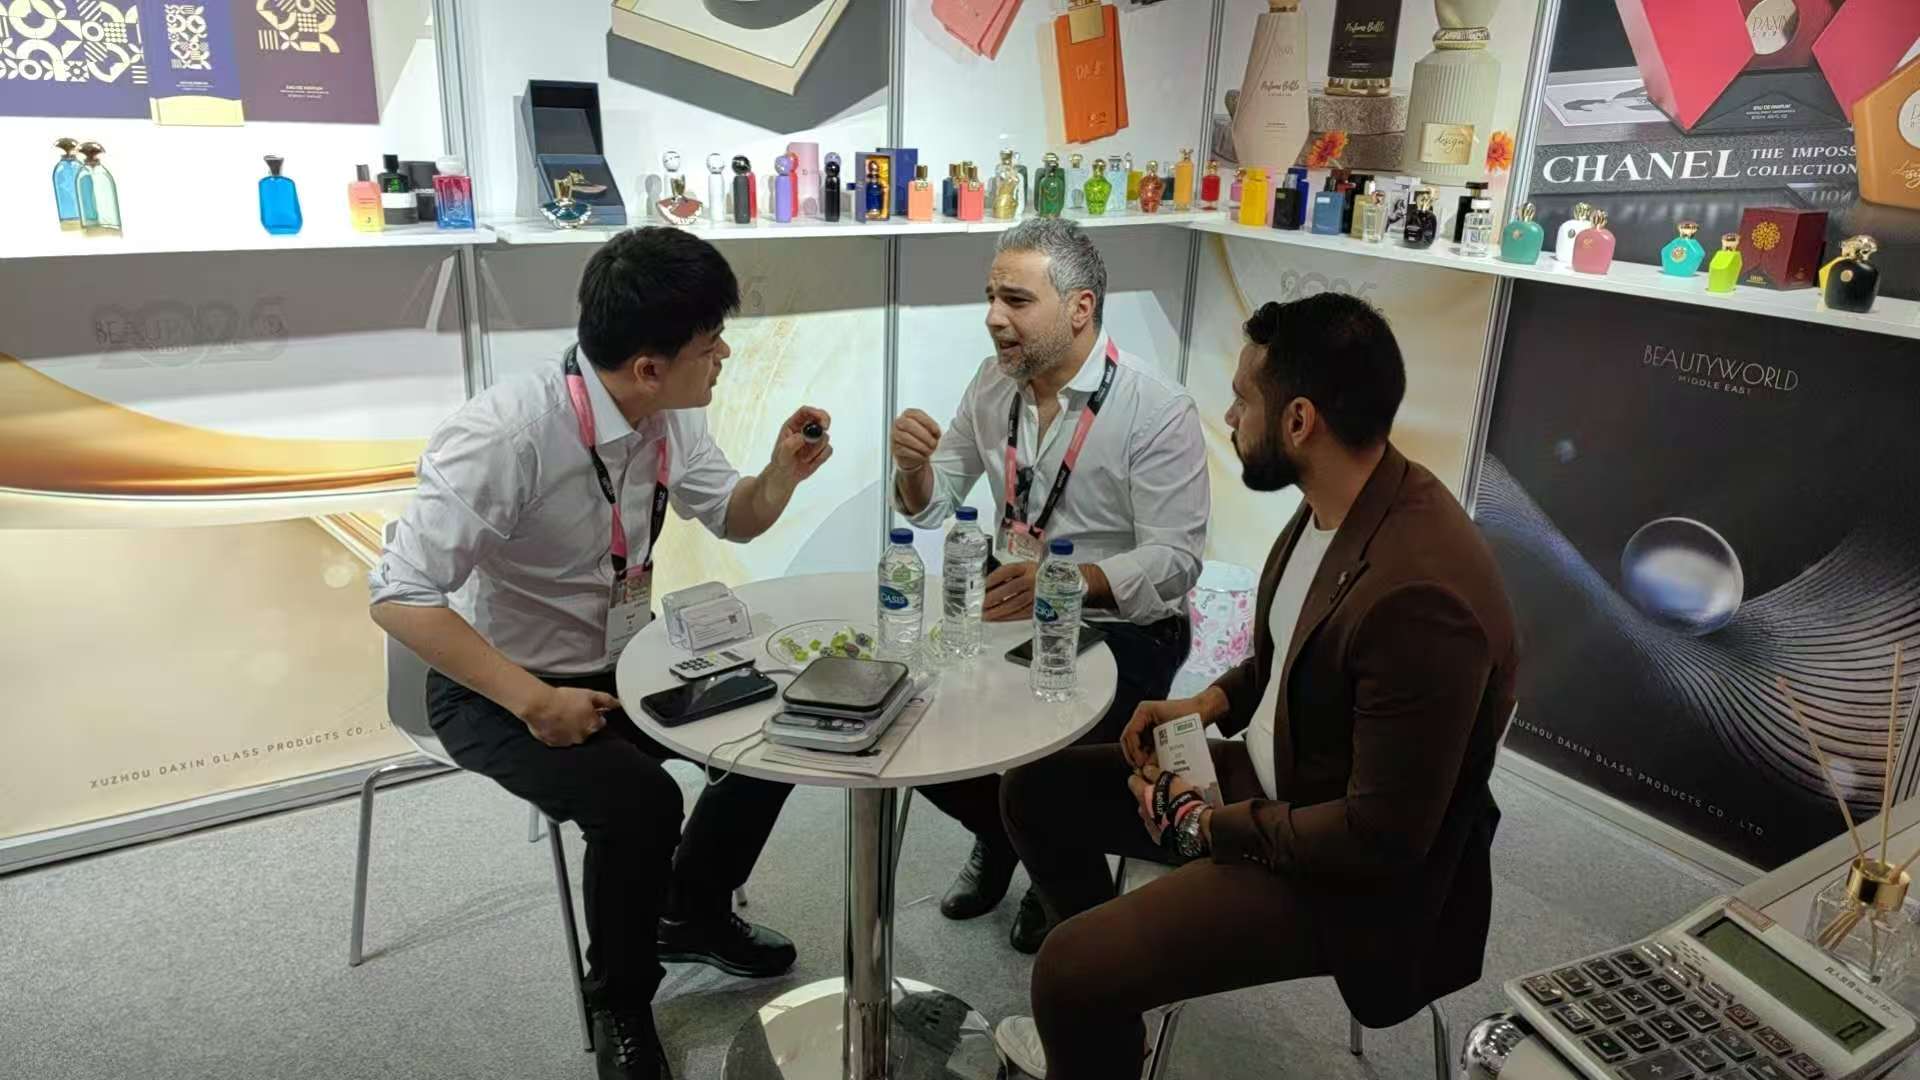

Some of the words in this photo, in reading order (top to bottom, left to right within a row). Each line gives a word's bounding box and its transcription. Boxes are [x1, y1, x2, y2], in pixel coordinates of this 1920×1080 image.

[1542, 149, 1741, 184] CHANEL
[1746, 163, 1857, 178] COLLECTION
[1751, 147, 1786, 160] THE
[1643, 344, 1799, 391] BEAUTYWORLD
[1678, 374, 1720, 390] MIDDLE
[1724, 384, 1752, 396] EAST
[90, 769, 151, 790] XUZHOU
[159, 759, 205, 776] DAXIN
[212, 747, 259, 764] GLASS
[267, 731, 340, 753] PRODUCTS
[1557, 736, 1591, 757] DAXIN
[1596, 754, 1632, 777] GLASS
[1638, 772, 1702, 808] PRODUCTS
